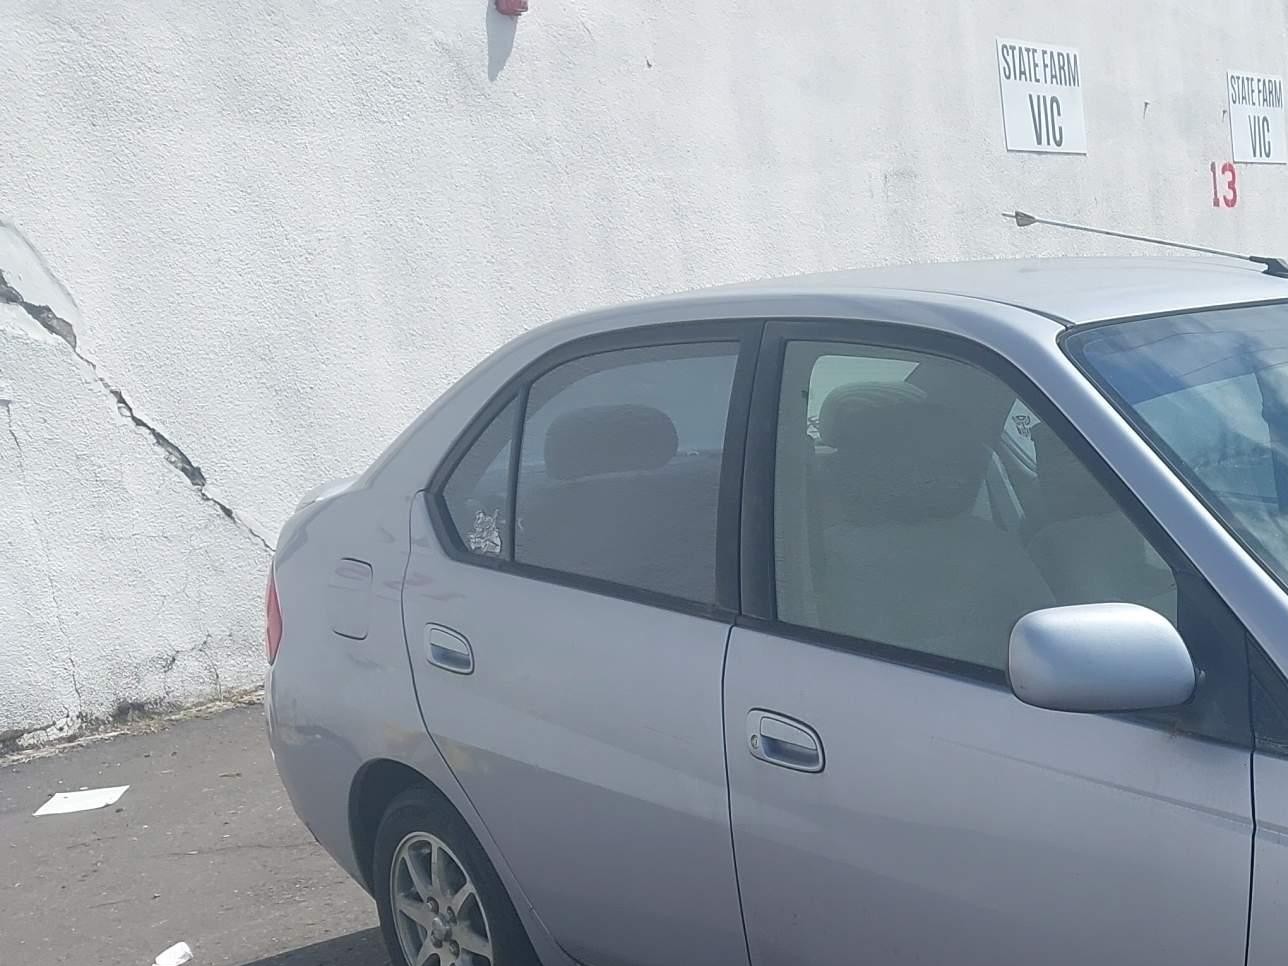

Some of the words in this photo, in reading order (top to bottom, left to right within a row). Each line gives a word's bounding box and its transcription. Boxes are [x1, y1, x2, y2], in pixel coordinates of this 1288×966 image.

[1001, 43, 1040, 83] STATE
[1042, 49, 1080, 87] FARM
[1230, 75, 1256, 106] STATE
[1257, 78, 1283, 109] FARM
[1028, 93, 1064, 147] VIC
[1248, 114, 1271, 158] VIC
[1210, 161, 1237, 208] 13
